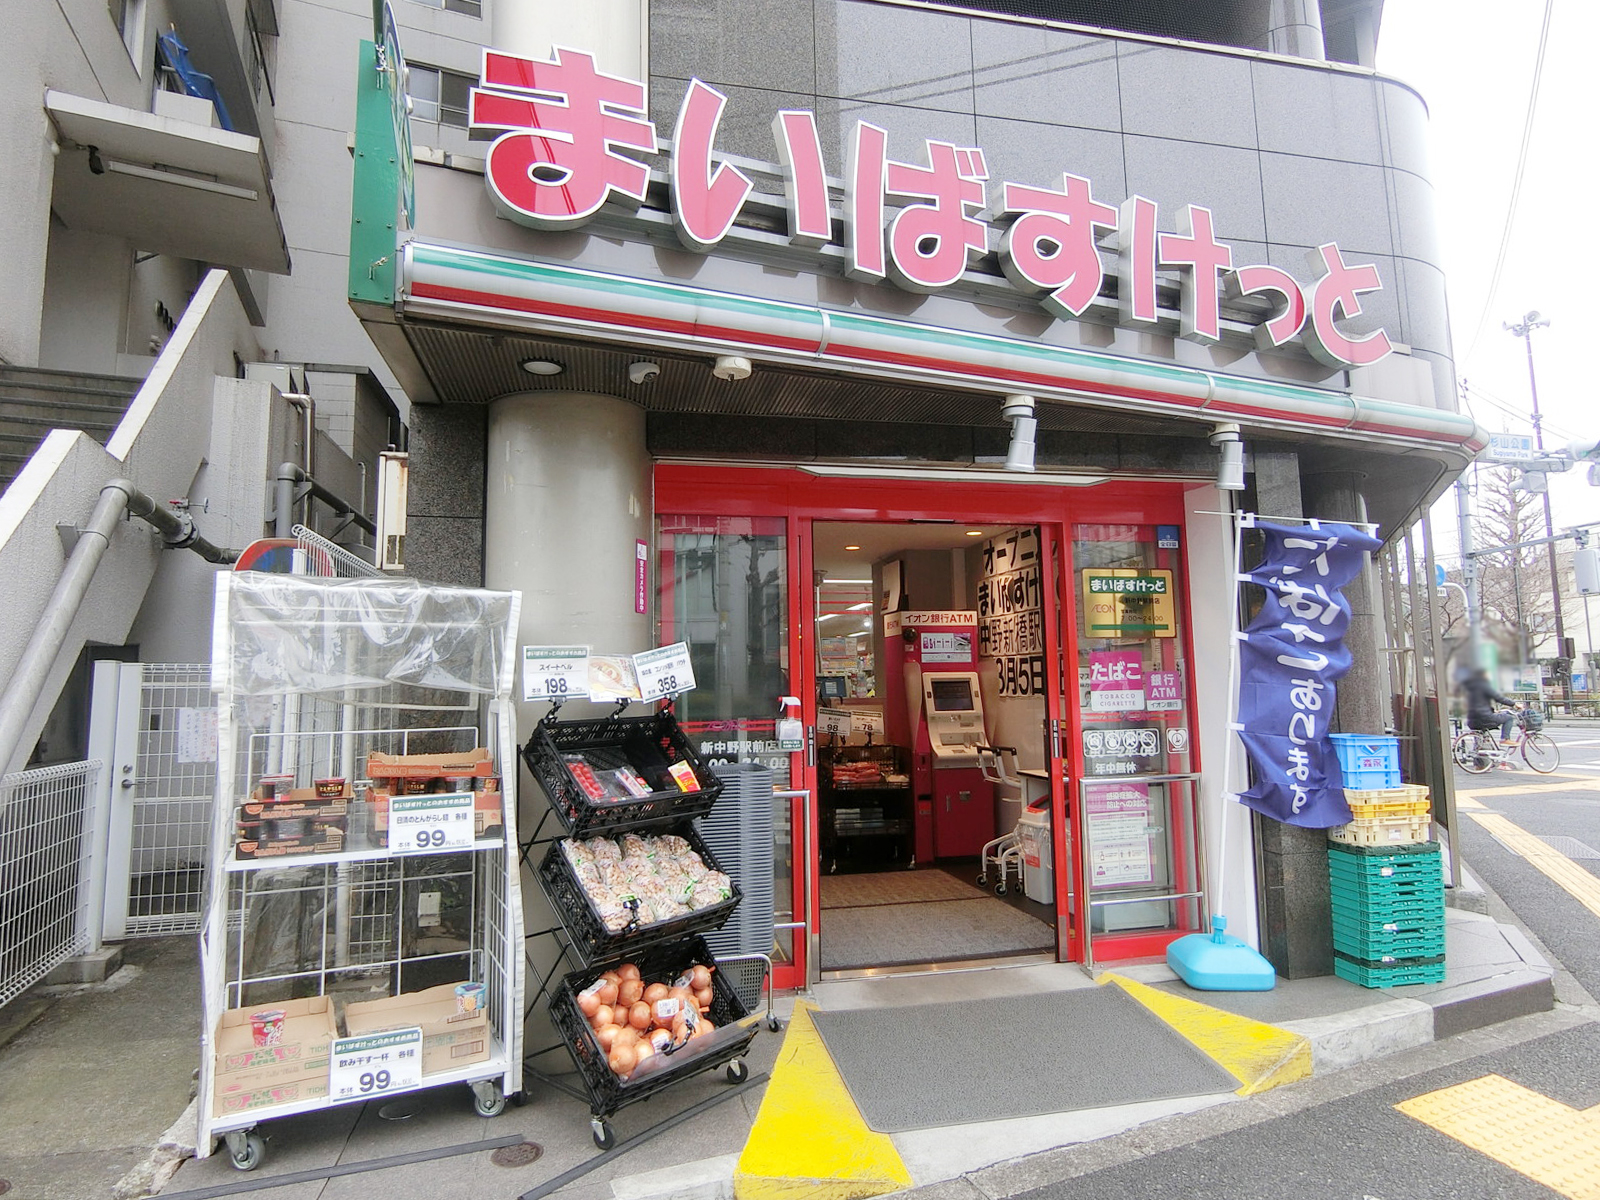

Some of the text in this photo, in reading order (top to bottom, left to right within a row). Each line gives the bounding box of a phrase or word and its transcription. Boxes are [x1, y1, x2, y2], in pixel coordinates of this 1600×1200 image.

[468, 46, 1393, 368] まいばすけっと
[1090, 579, 1166, 593] まいばすけっと
[1091, 660, 1141, 681] たばこ
[545, 678, 568, 693] 198
[657, 675, 678, 693] 358
[1150, 673, 1174, 686] 銀行
[1151, 687, 1177, 698] ATM
[827, 723, 839, 732] 98
[861, 723, 874, 731] 78
[1095, 761, 1137, 774] 年中無休
[416, 829, 446, 848] 99
[339, 1052, 389, 1068] 飲み干す一杯
[359, 1069, 391, 1092] 99
